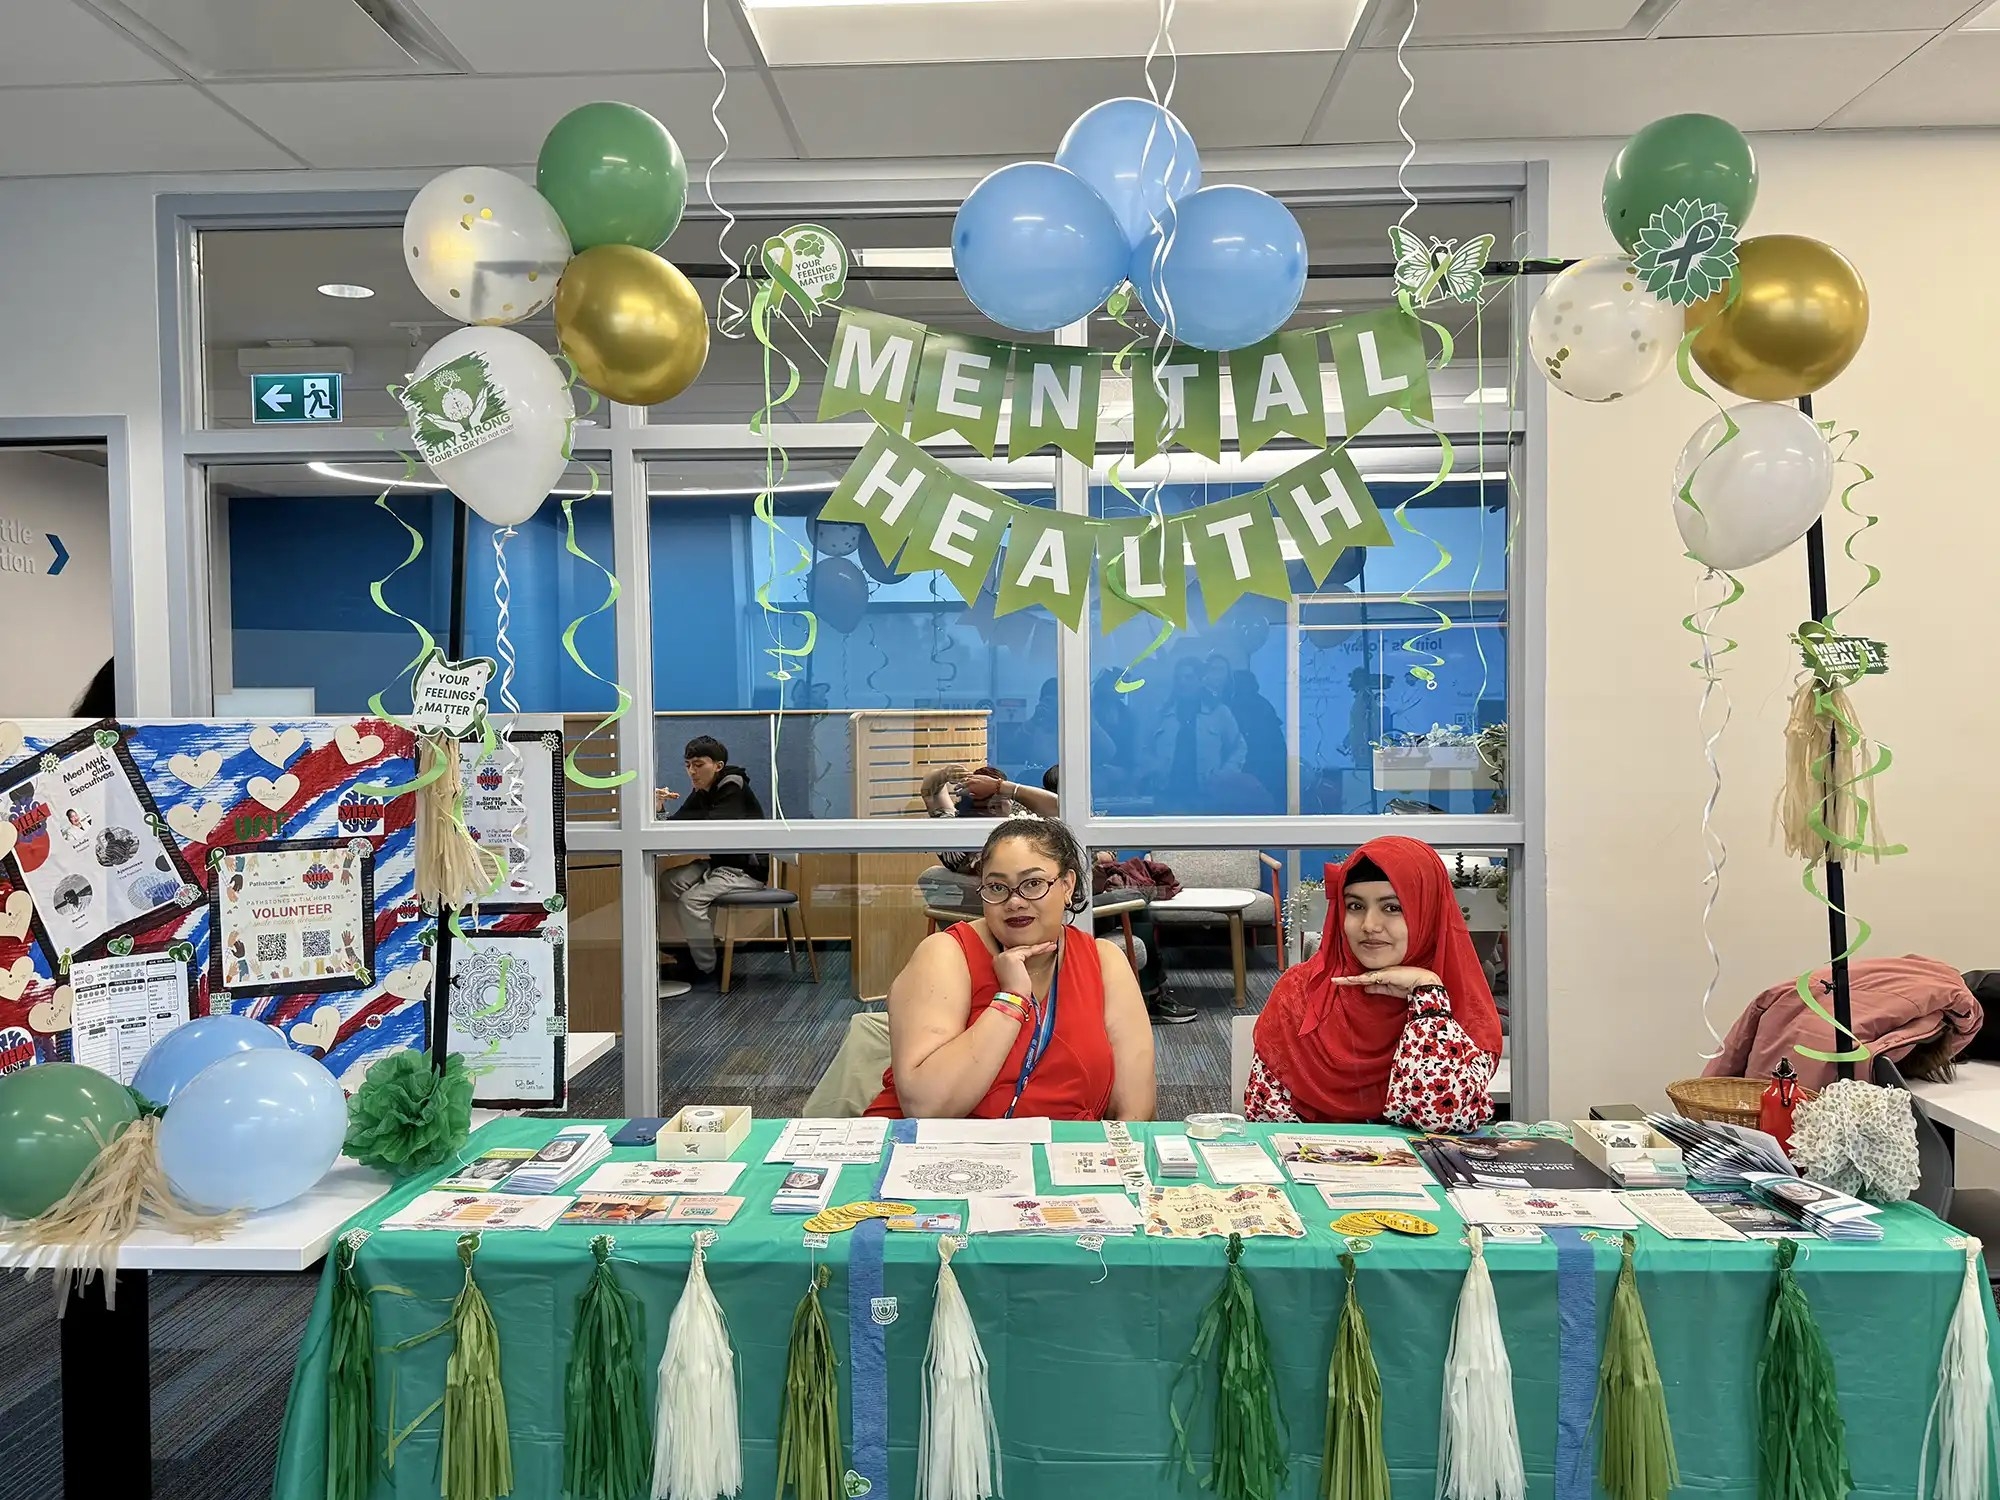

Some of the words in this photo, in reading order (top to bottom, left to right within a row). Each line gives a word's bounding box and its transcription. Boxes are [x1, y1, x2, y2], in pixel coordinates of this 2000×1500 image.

[795, 259, 821, 271] YOUR
[797, 263, 838, 279] FEELINGS
[800, 273, 835, 287] MATTER
[833, 325, 1408, 430] MENTAL
[426, 436, 457, 458] STAY
[459, 413, 511, 443] STRONG
[428, 451, 453, 465] YOUR
[454, 438, 480, 456] STORY
[488, 430, 500, 440] not
[500, 424, 515, 436] over
[853, 447, 1363, 599] HEALTH
[1812, 640, 1874, 655] MENTAL
[439, 674, 470, 686] YOUR
[425, 688, 476, 701] FEELINGS
[424, 702, 470, 716] MATTER
[63, 769, 87, 783] Meet
[86, 755, 108, 771] MHA
[92, 763, 111, 778] club
[69, 770, 115, 797] Executives
[340, 806, 380, 818] MHA
[235, 812, 290, 841] UNF
[351, 818, 371, 826] UNF
[249, 880, 279, 888] Pathstone
[252, 903, 332, 919] VOLUNTEER
[1175, 1203, 1260, 1214] VOLUNTEER
